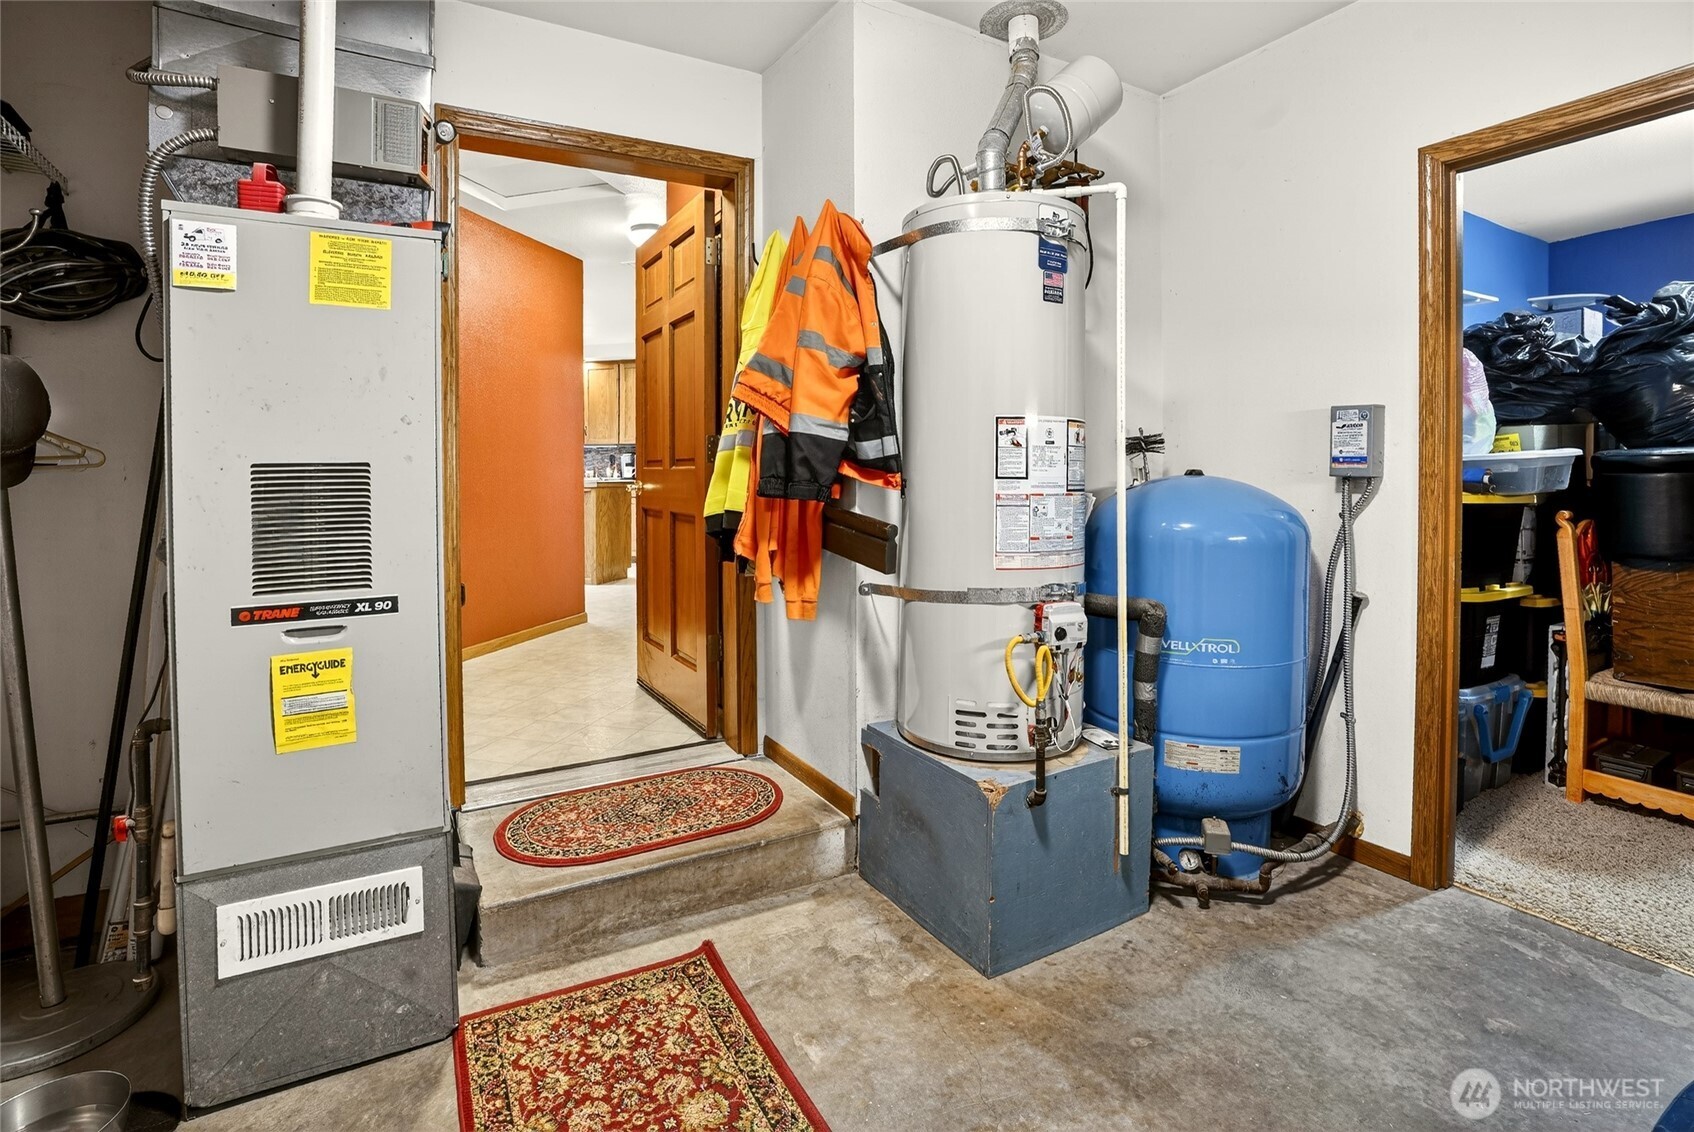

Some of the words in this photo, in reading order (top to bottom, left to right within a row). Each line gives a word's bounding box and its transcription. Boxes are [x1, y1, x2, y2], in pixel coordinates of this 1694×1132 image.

[253, 607, 300, 621] TRANE
[354, 602, 372, 613] XL
[374, 600, 393, 611] 90
[279, 658, 346, 677] ENERGYGUIDE
